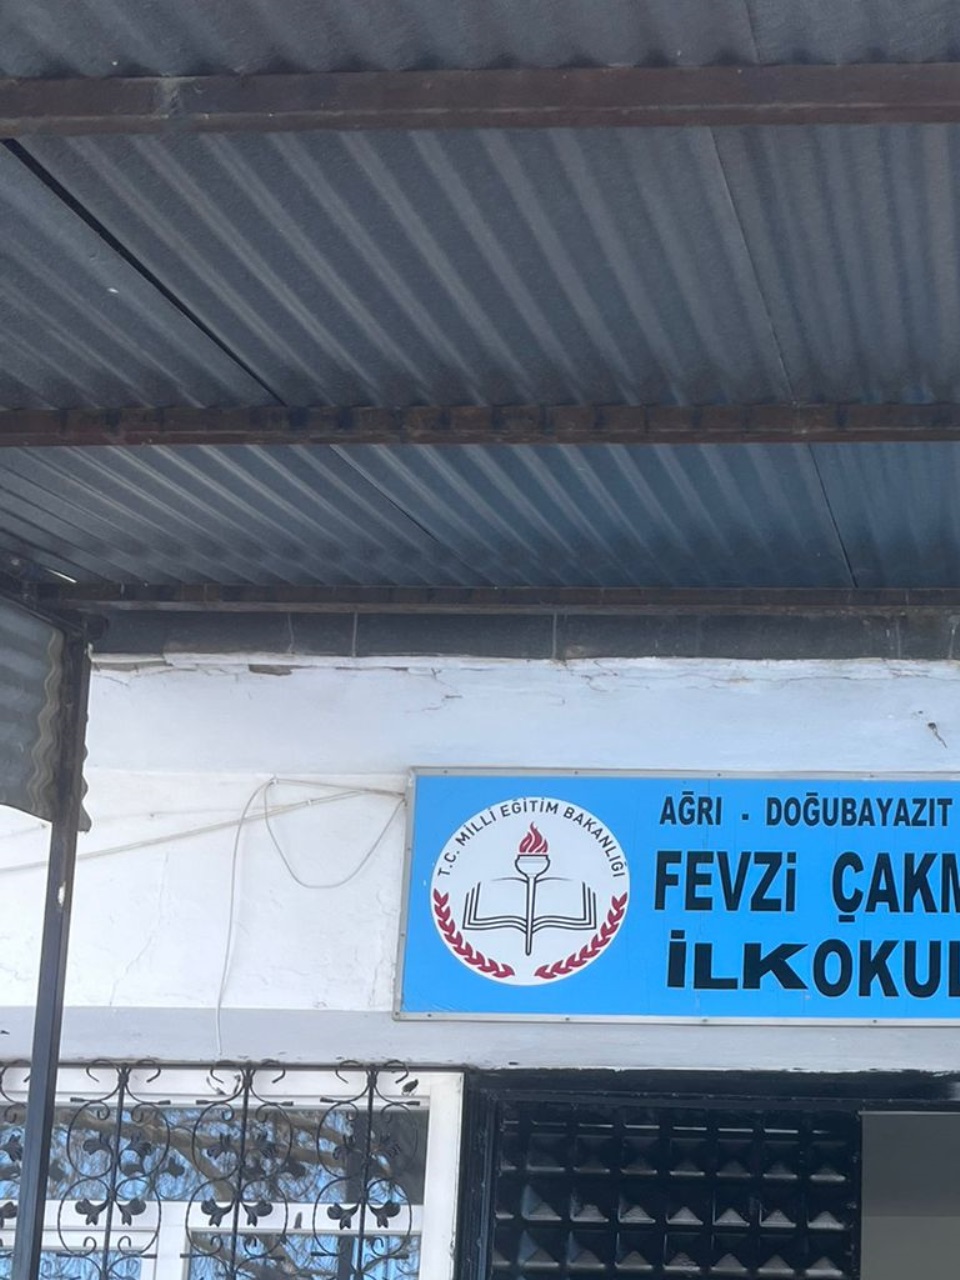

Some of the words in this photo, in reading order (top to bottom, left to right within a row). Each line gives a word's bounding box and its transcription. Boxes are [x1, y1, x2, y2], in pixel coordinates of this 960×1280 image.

[455, 807, 498, 847] MİLLİ
[500, 797, 560, 818] EĞİTİM
[563, 805, 628, 878] BAKANLIĞI
[659, 790, 722, 826] AĞRI
[765, 792, 953, 827] DOĞUBAYAZIT
